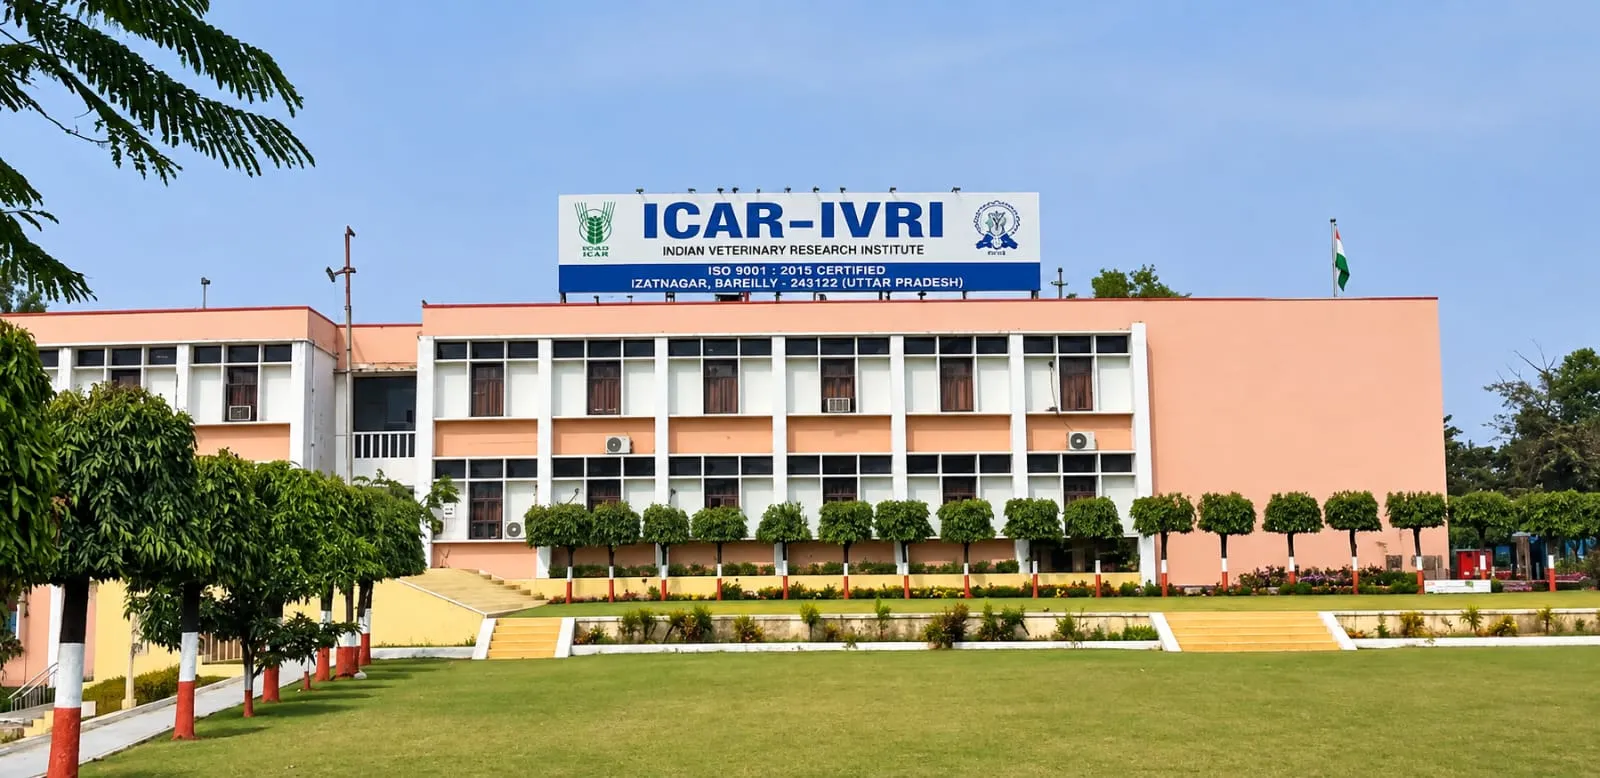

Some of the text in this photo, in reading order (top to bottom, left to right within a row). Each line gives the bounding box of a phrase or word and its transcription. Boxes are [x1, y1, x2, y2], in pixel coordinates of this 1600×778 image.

[643, 202, 944, 240] ICAR-IVRI
[662, 244, 925, 257] INDIAN VETERINARY RESEARCH INSTITUTE
[708, 266, 731, 276] ISO
[735, 266, 766, 276] 9001
[780, 265, 813, 275] 2015
[816, 265, 886, 275] CERTIFIED
[631, 278, 711, 290] IZATNAGAR,
[715, 278, 778, 288] BAREILLY
[790, 278, 838, 288] 243122
[842, 277, 891, 289] (UTTAR
[895, 277, 963, 289] PRADESH)
